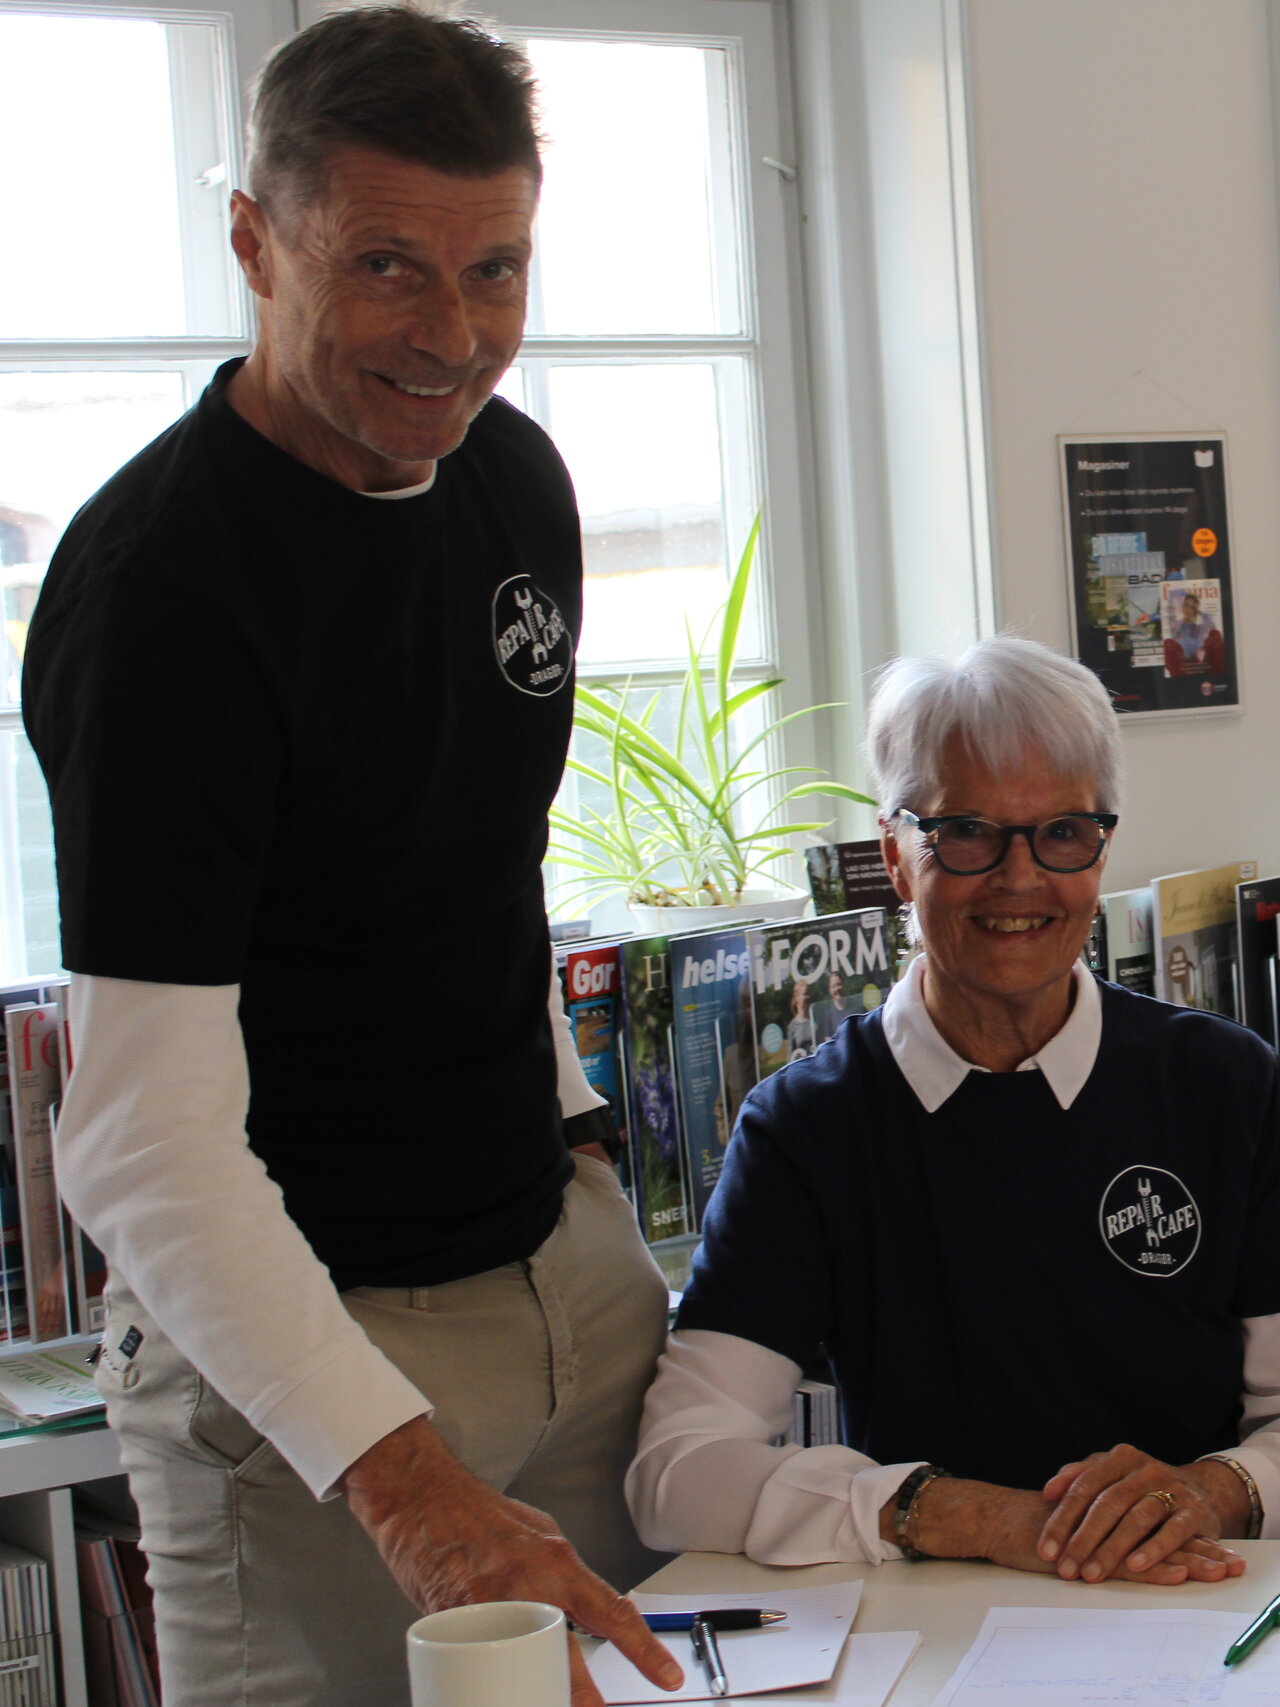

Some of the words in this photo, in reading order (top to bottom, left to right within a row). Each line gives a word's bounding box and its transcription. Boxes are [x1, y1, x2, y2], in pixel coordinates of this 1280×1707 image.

[1162, 582, 1218, 601] fina
[572, 959, 616, 996] Gør
[754, 926, 888, 995] iFORM
[1158, 1204, 1196, 1239] CAFE
